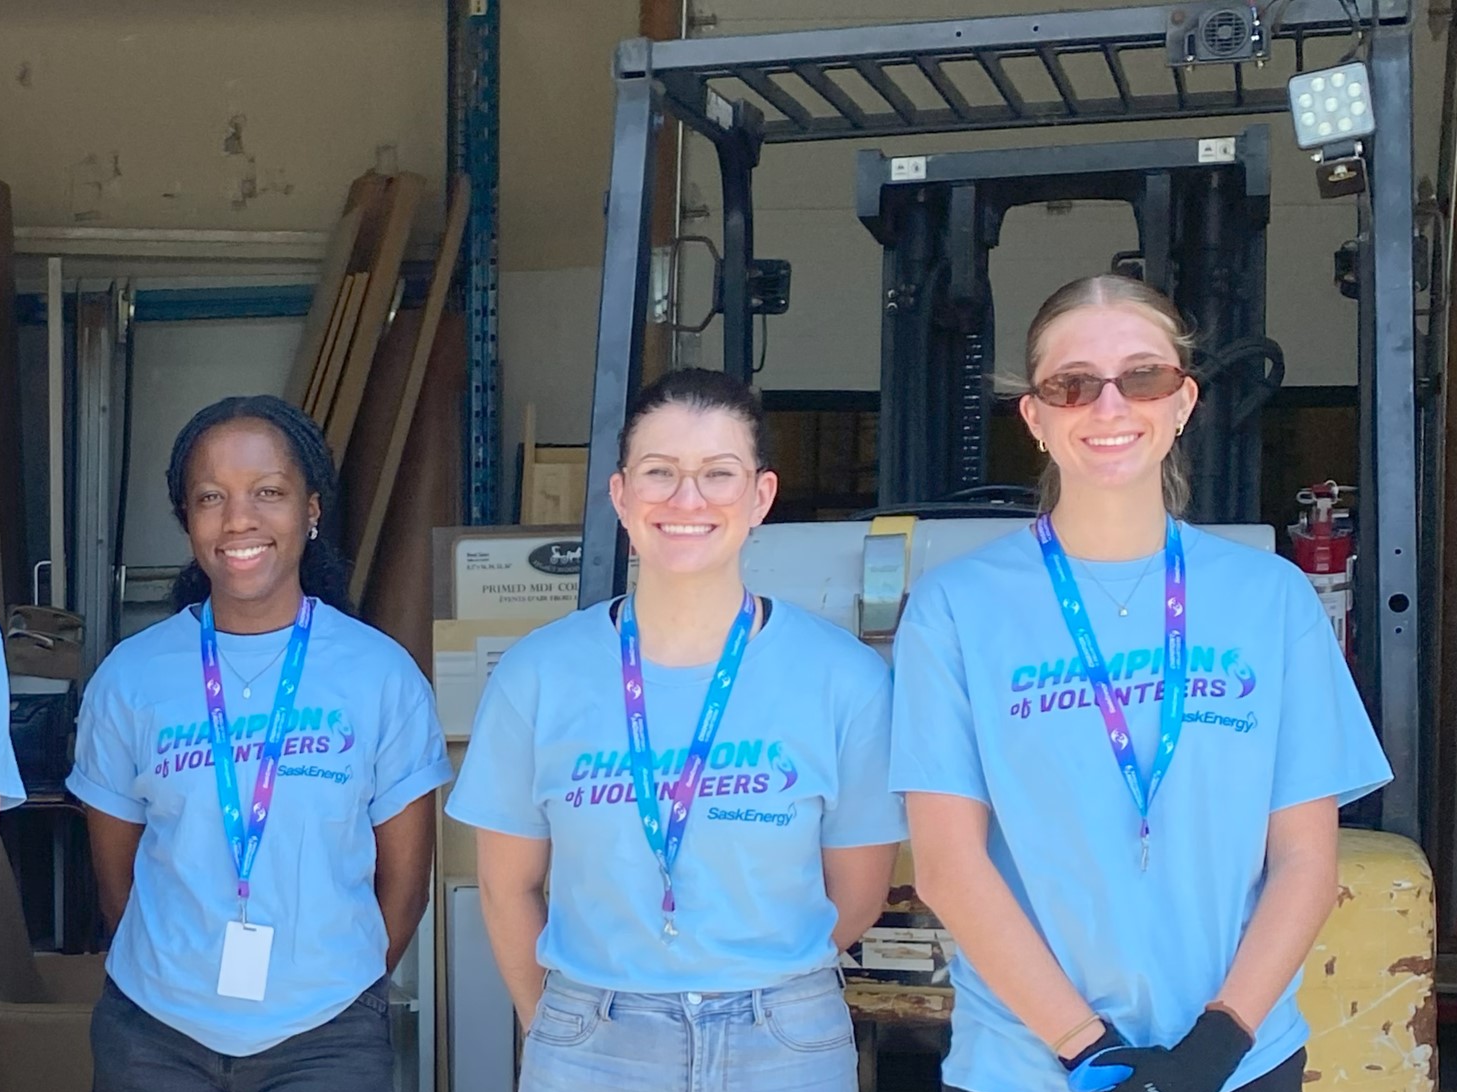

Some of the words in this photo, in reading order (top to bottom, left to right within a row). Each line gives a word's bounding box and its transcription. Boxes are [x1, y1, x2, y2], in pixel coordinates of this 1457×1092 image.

[482, 583, 526, 594] PRIMED
[529, 582, 553, 592] MDF
[1010, 646, 1215, 692] CHAMPIN
[1010, 697, 1032, 719] of
[1040, 677, 1226, 713] VOLNTERS
[155, 759, 169, 778] of
[175, 735, 330, 772] VOLNTERS
[277, 765, 350, 784] SaskEnergy
[565, 786, 585, 808] of
[590, 773, 770, 805] VOLNEERS
[707, 807, 793, 826] SaskEnergy
